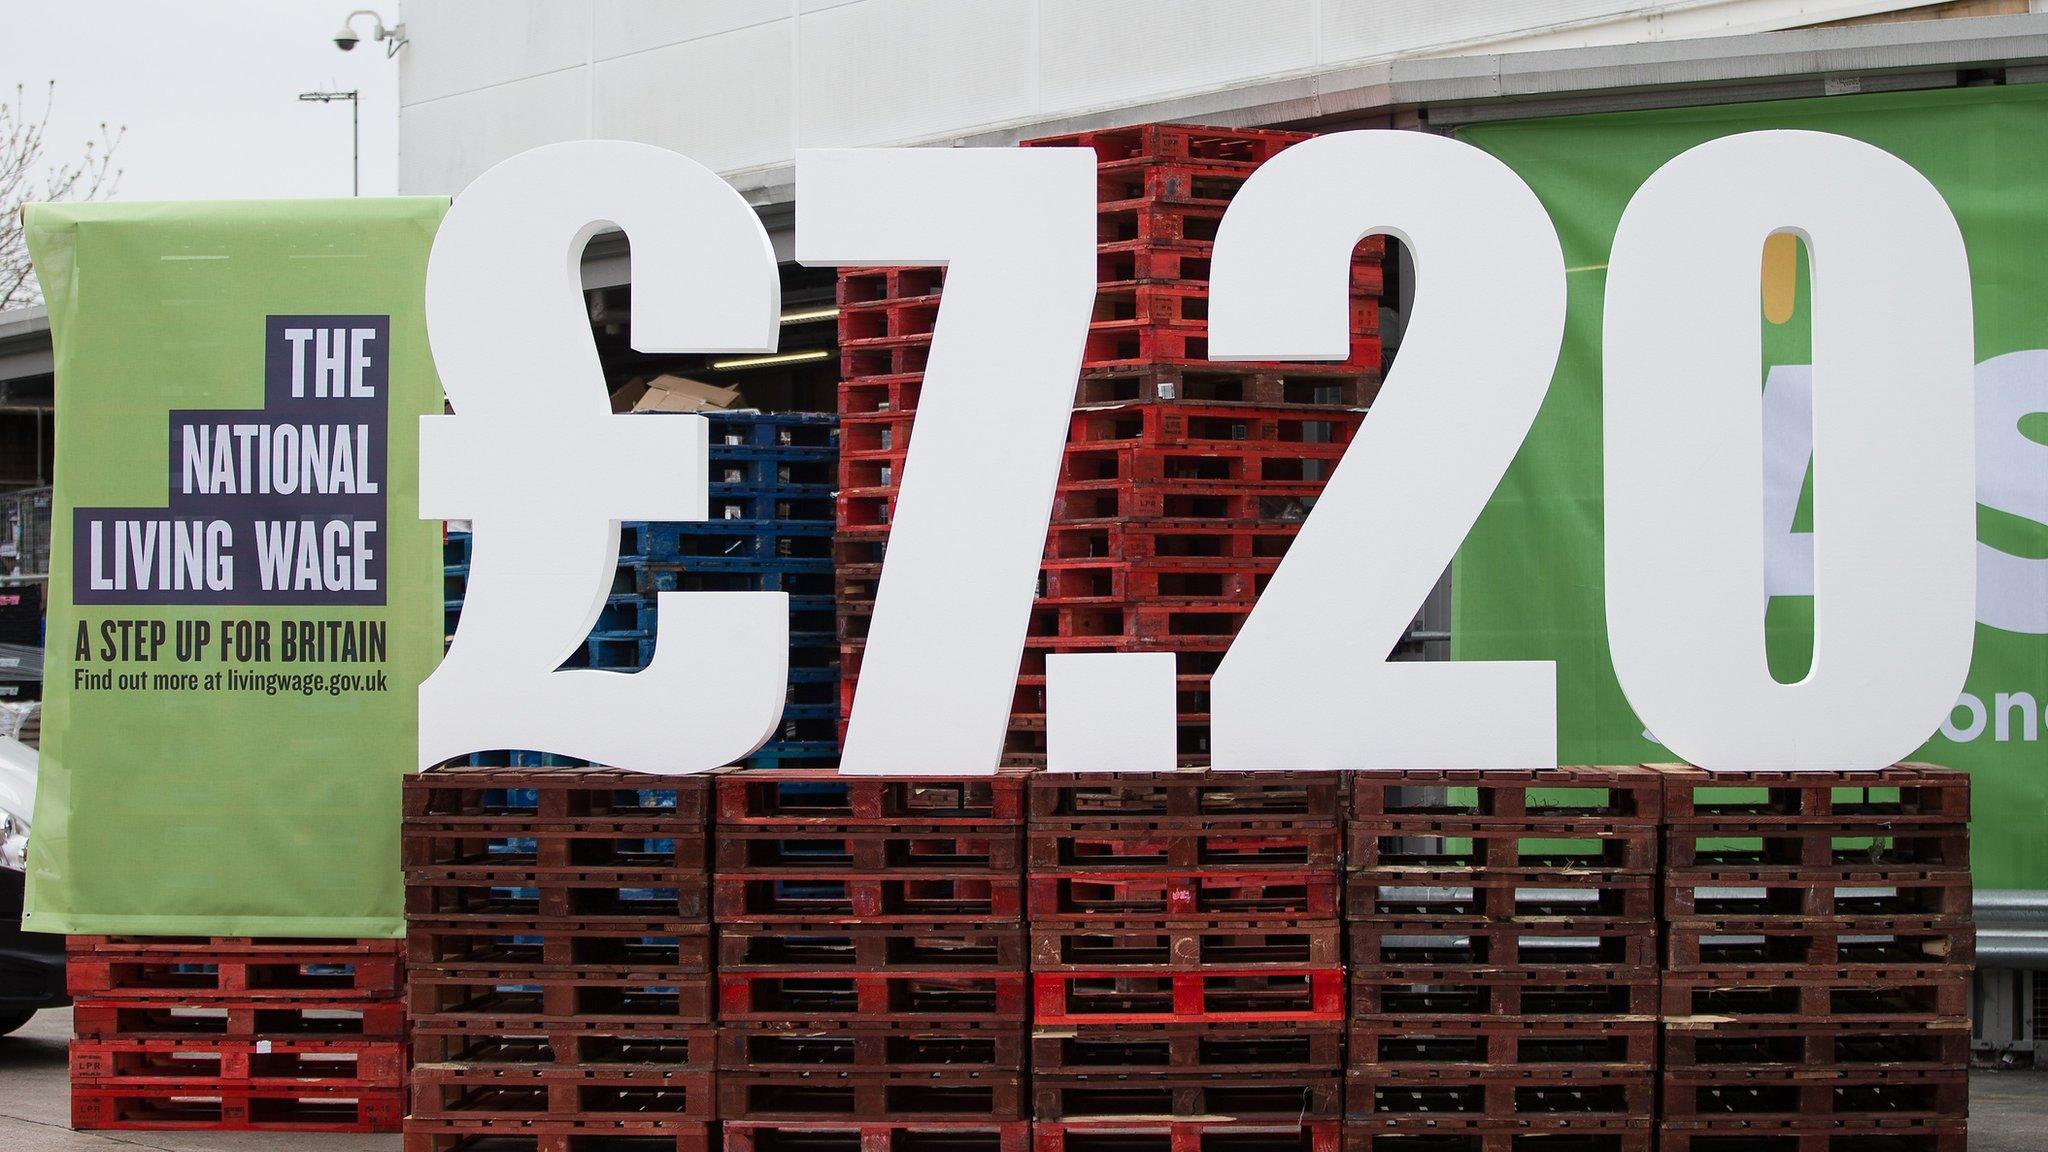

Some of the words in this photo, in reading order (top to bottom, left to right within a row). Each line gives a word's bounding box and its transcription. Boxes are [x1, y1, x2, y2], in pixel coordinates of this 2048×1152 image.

[284, 328, 377, 398] THE
[182, 423, 379, 496] NATIONAL
[90, 519, 235, 592] LIVING
[254, 519, 378, 592] WAGE
[75, 620, 92, 662] A
[100, 619, 167, 662] STEP
[175, 620, 211, 662] UP
[220, 620, 272, 663] FOR
[281, 620, 388, 664] BRITAIN
[74, 668, 113, 691] Find
[118, 671, 148, 691] out
[153, 673, 199, 691] more
[203, 671, 223, 691] at
[227, 669, 388, 696] livingwage.gov.uk
[79, 1062, 102, 1071] LPR
